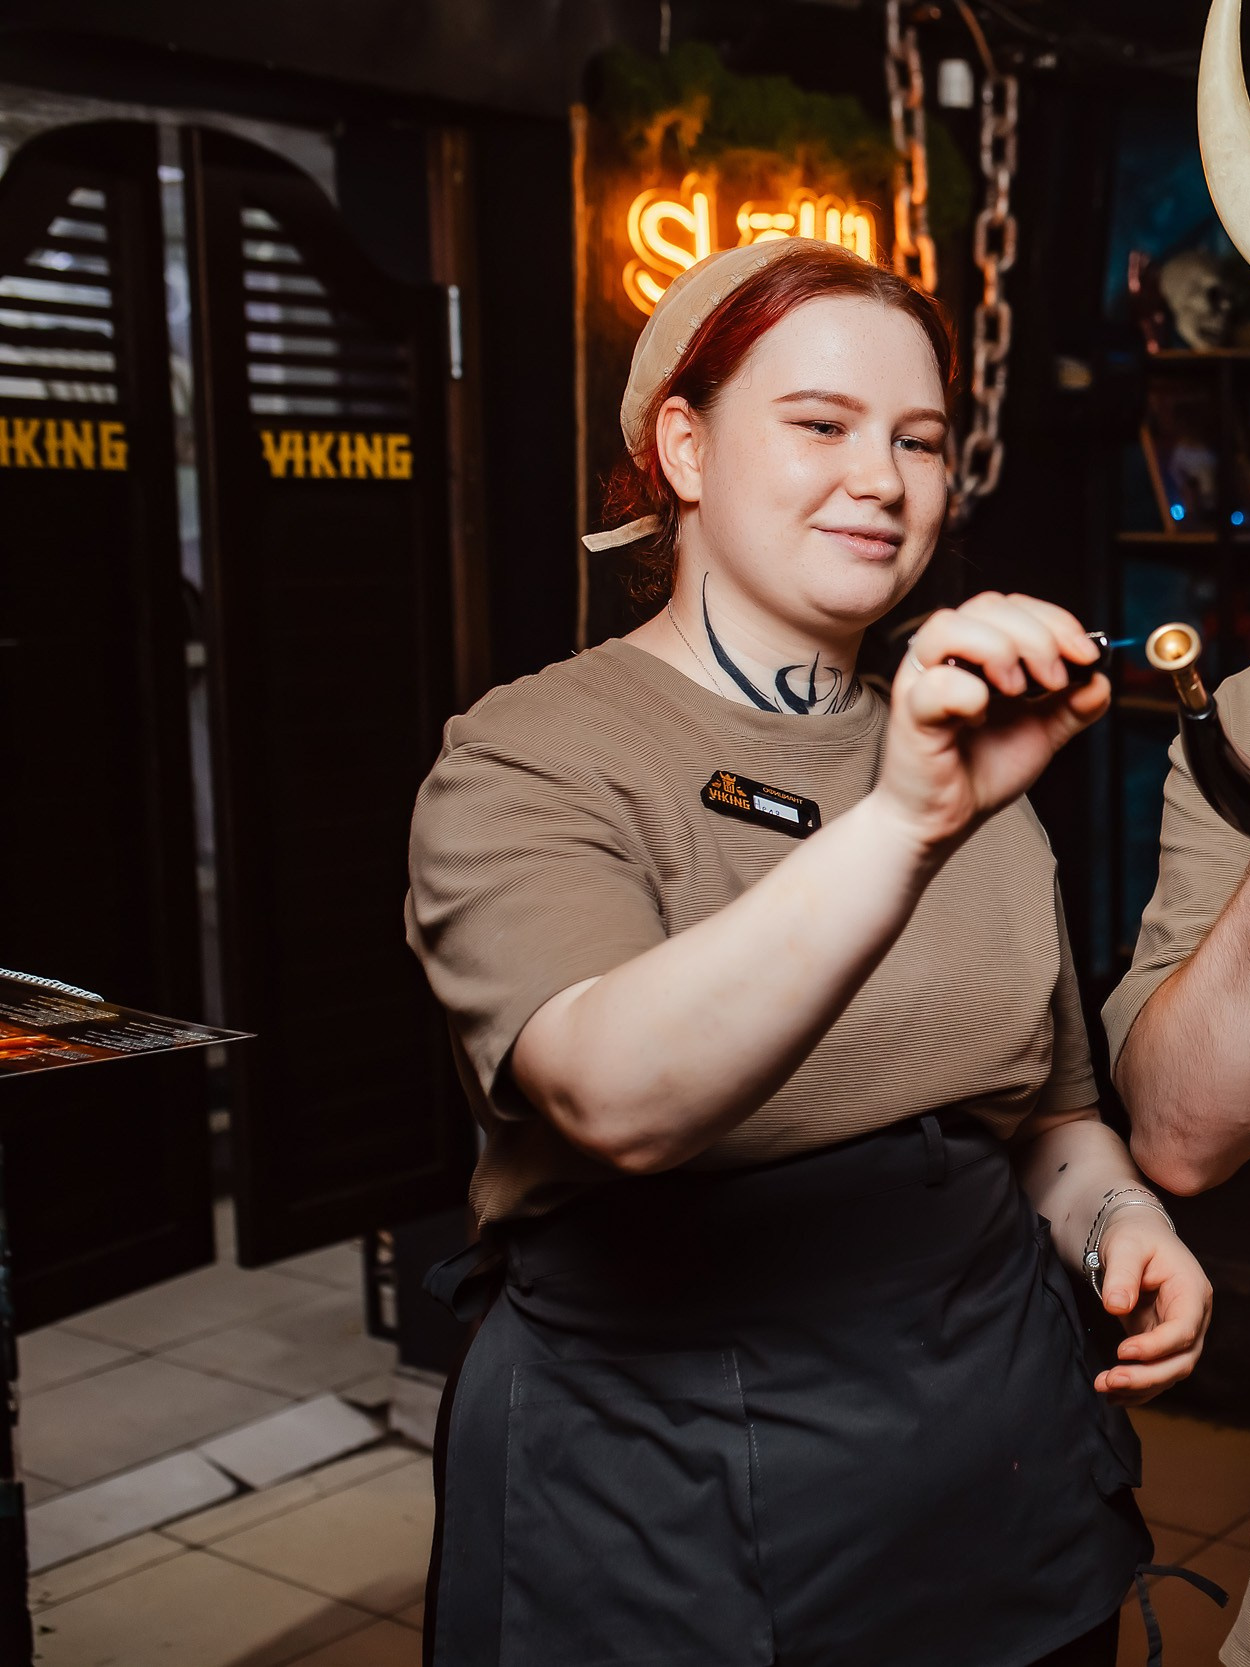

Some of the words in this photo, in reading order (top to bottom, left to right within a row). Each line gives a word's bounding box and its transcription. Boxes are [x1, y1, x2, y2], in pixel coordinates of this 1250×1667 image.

[0, 416, 128, 470] IKING
[261, 430, 412, 479] VIKING
[708, 787, 751, 810] VIKING
